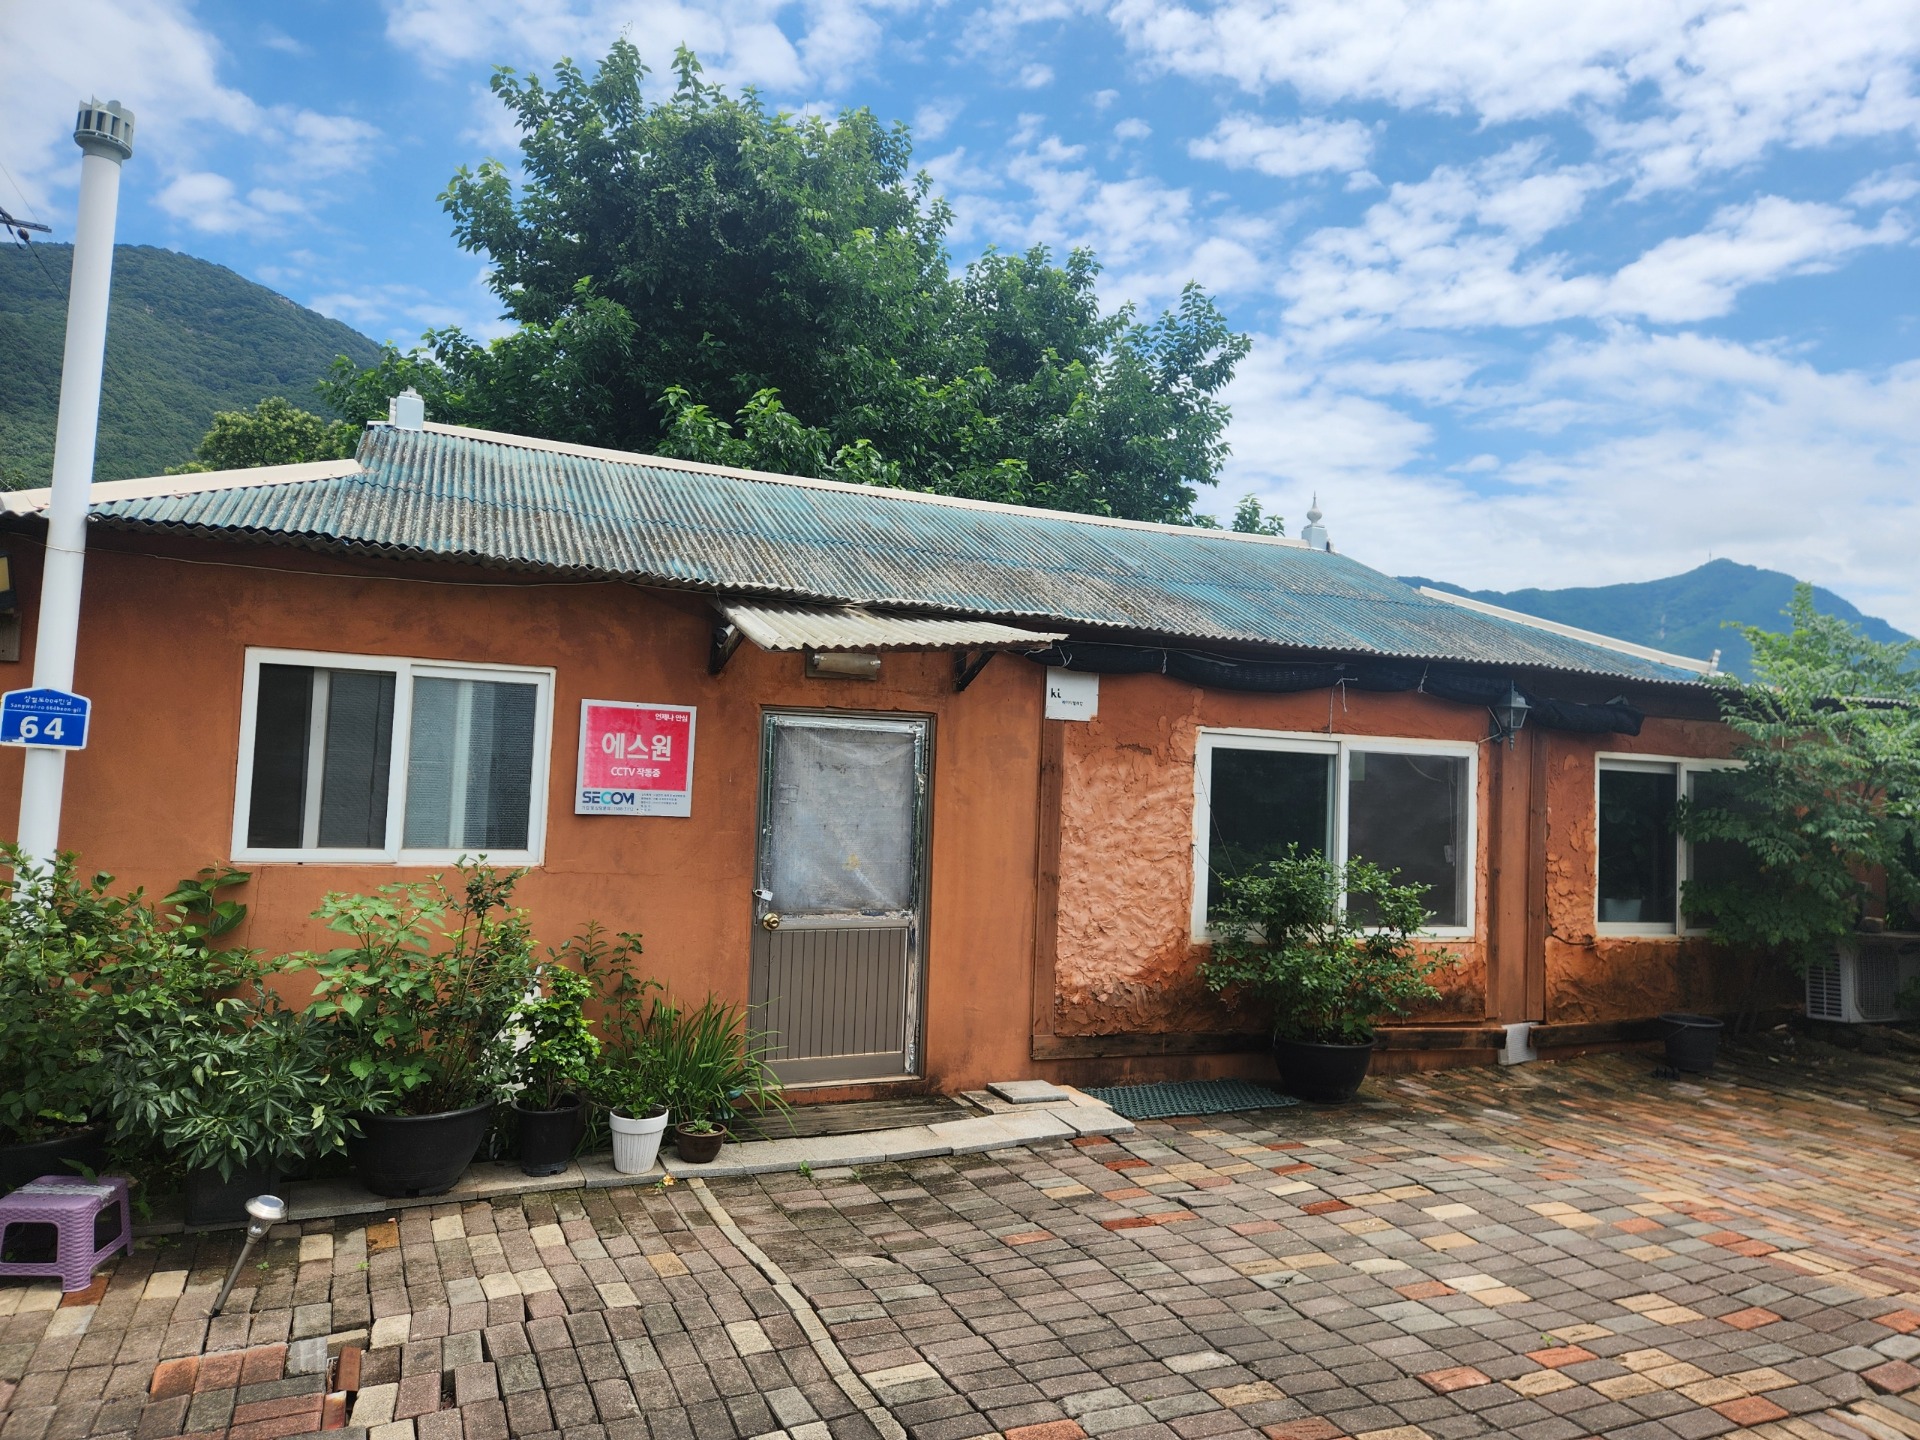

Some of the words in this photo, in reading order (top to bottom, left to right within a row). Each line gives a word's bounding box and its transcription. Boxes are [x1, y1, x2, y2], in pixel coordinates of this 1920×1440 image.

[655, 713, 674, 722] 언제나
[675, 714, 688, 722] 안심
[20, 715, 65, 740] 64
[601, 732, 672, 762] 에스원
[610, 766, 635, 777] CCTV
[636, 768, 660, 778] 작동중
[582, 791, 635, 805] SECOM
